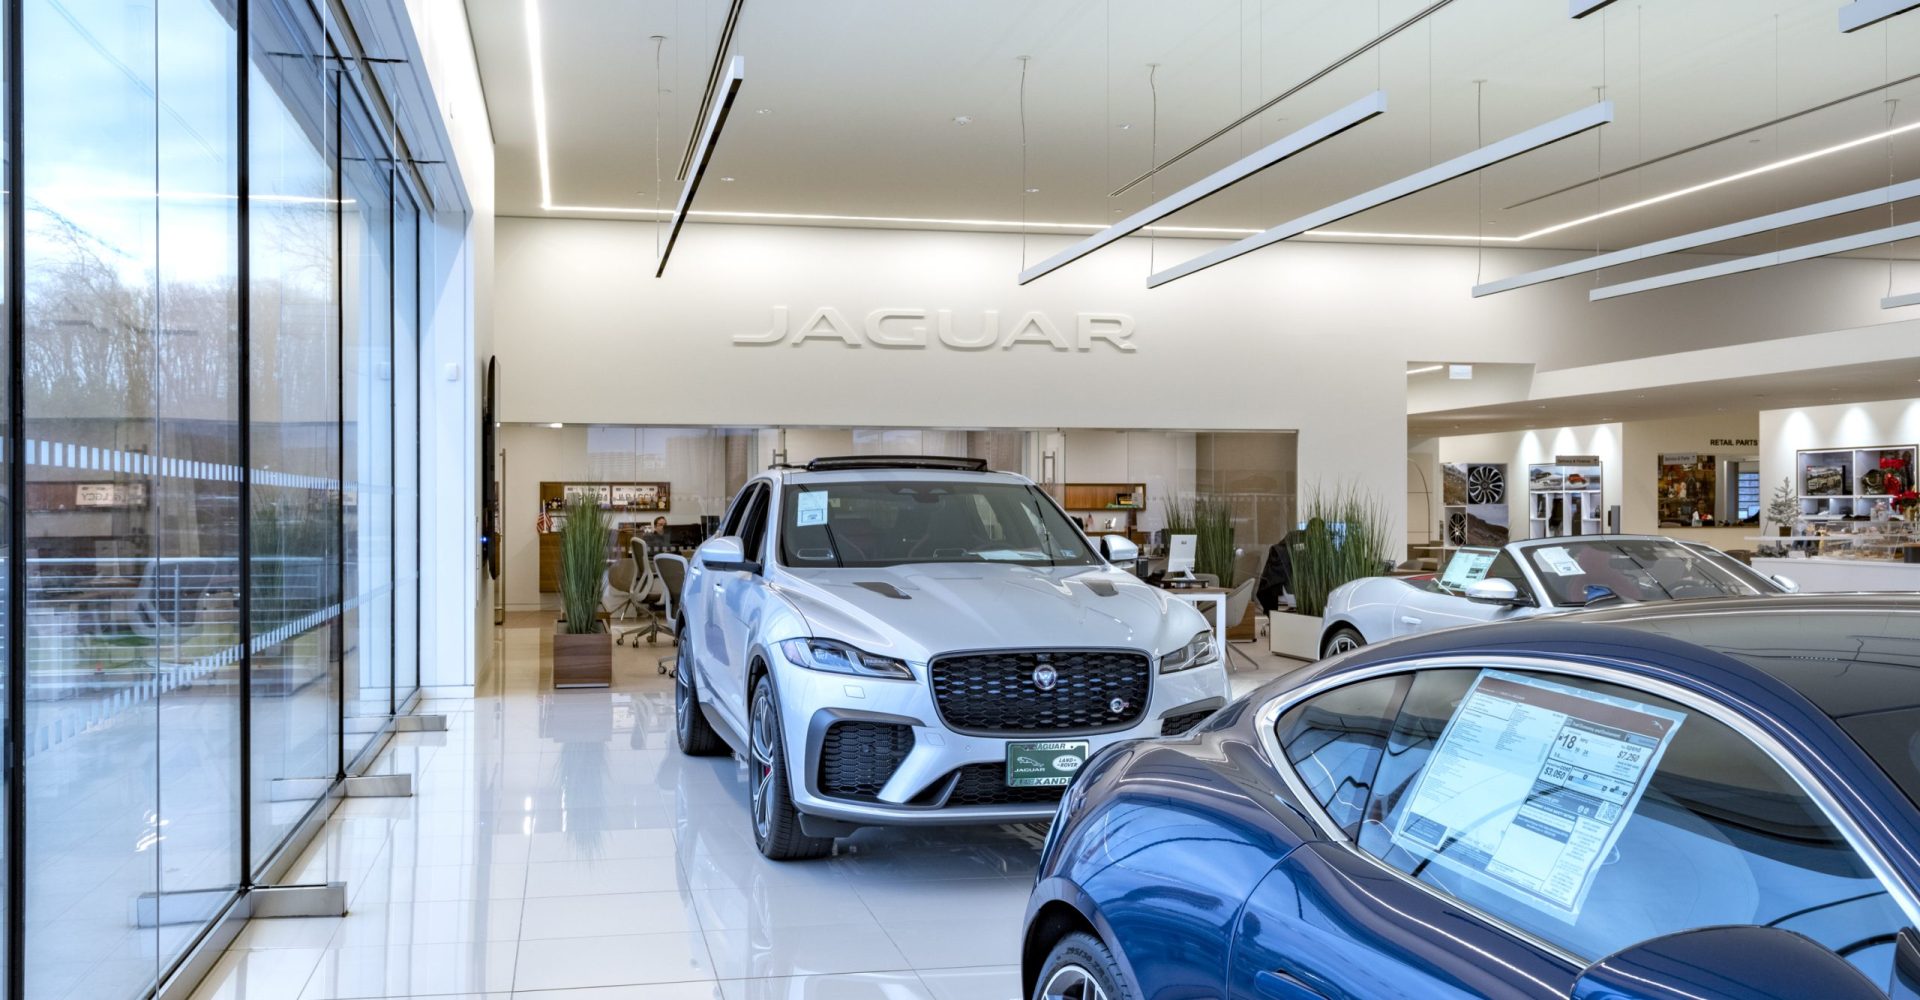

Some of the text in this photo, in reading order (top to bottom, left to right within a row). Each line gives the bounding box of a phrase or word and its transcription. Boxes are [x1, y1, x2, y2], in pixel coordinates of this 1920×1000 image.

[732, 305, 1137, 353] JAGUAR
[1710, 438, 1758, 446] RETAIL PARTS
[1561, 734, 1577, 749] 18
[1544, 767, 1566, 779] $3,050
